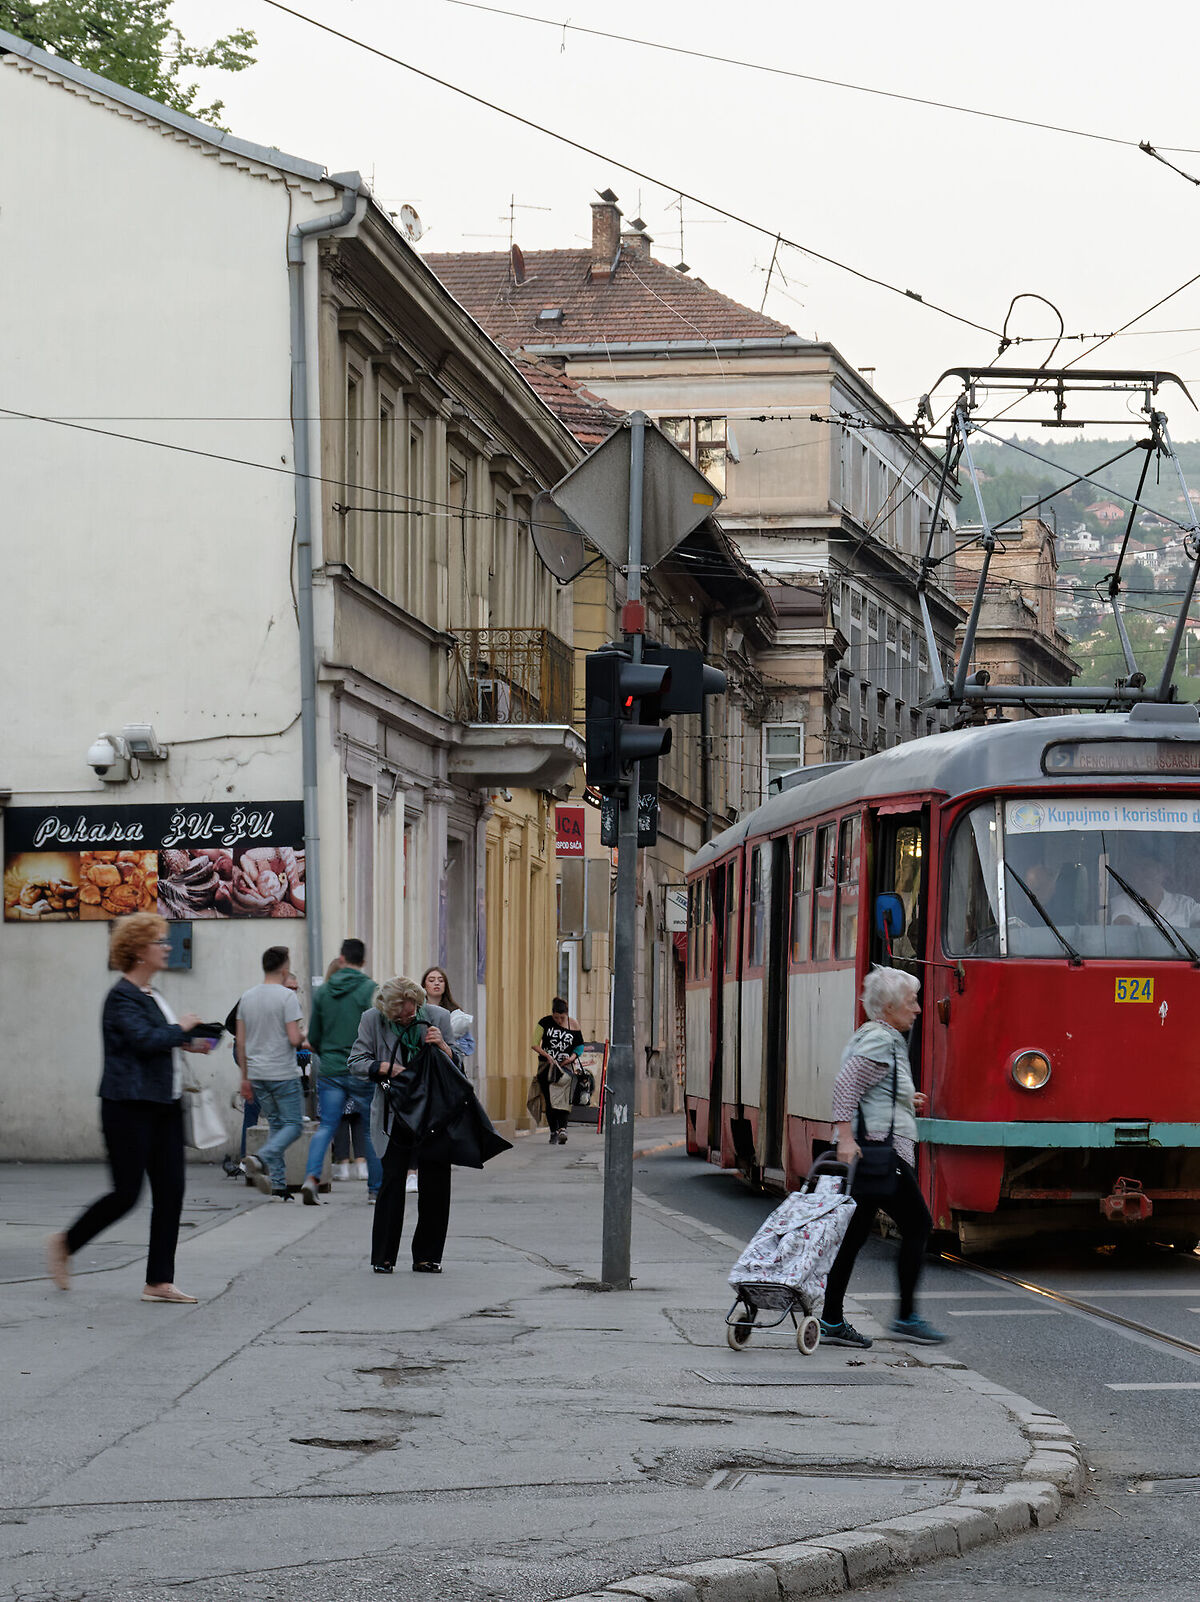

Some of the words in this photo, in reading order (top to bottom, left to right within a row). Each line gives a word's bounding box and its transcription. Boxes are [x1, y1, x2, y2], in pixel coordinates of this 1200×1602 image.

[1048, 807, 1110, 825] Kupujmo
[1114, 806, 1118, 822] i
[1122, 807, 1188, 823] koristimo
[33, 815, 144, 847] Pekara
[1117, 979, 1152, 1000] 524
[546, 1027, 574, 1046] NEVER
[549, 1040, 569, 1052] SAY
